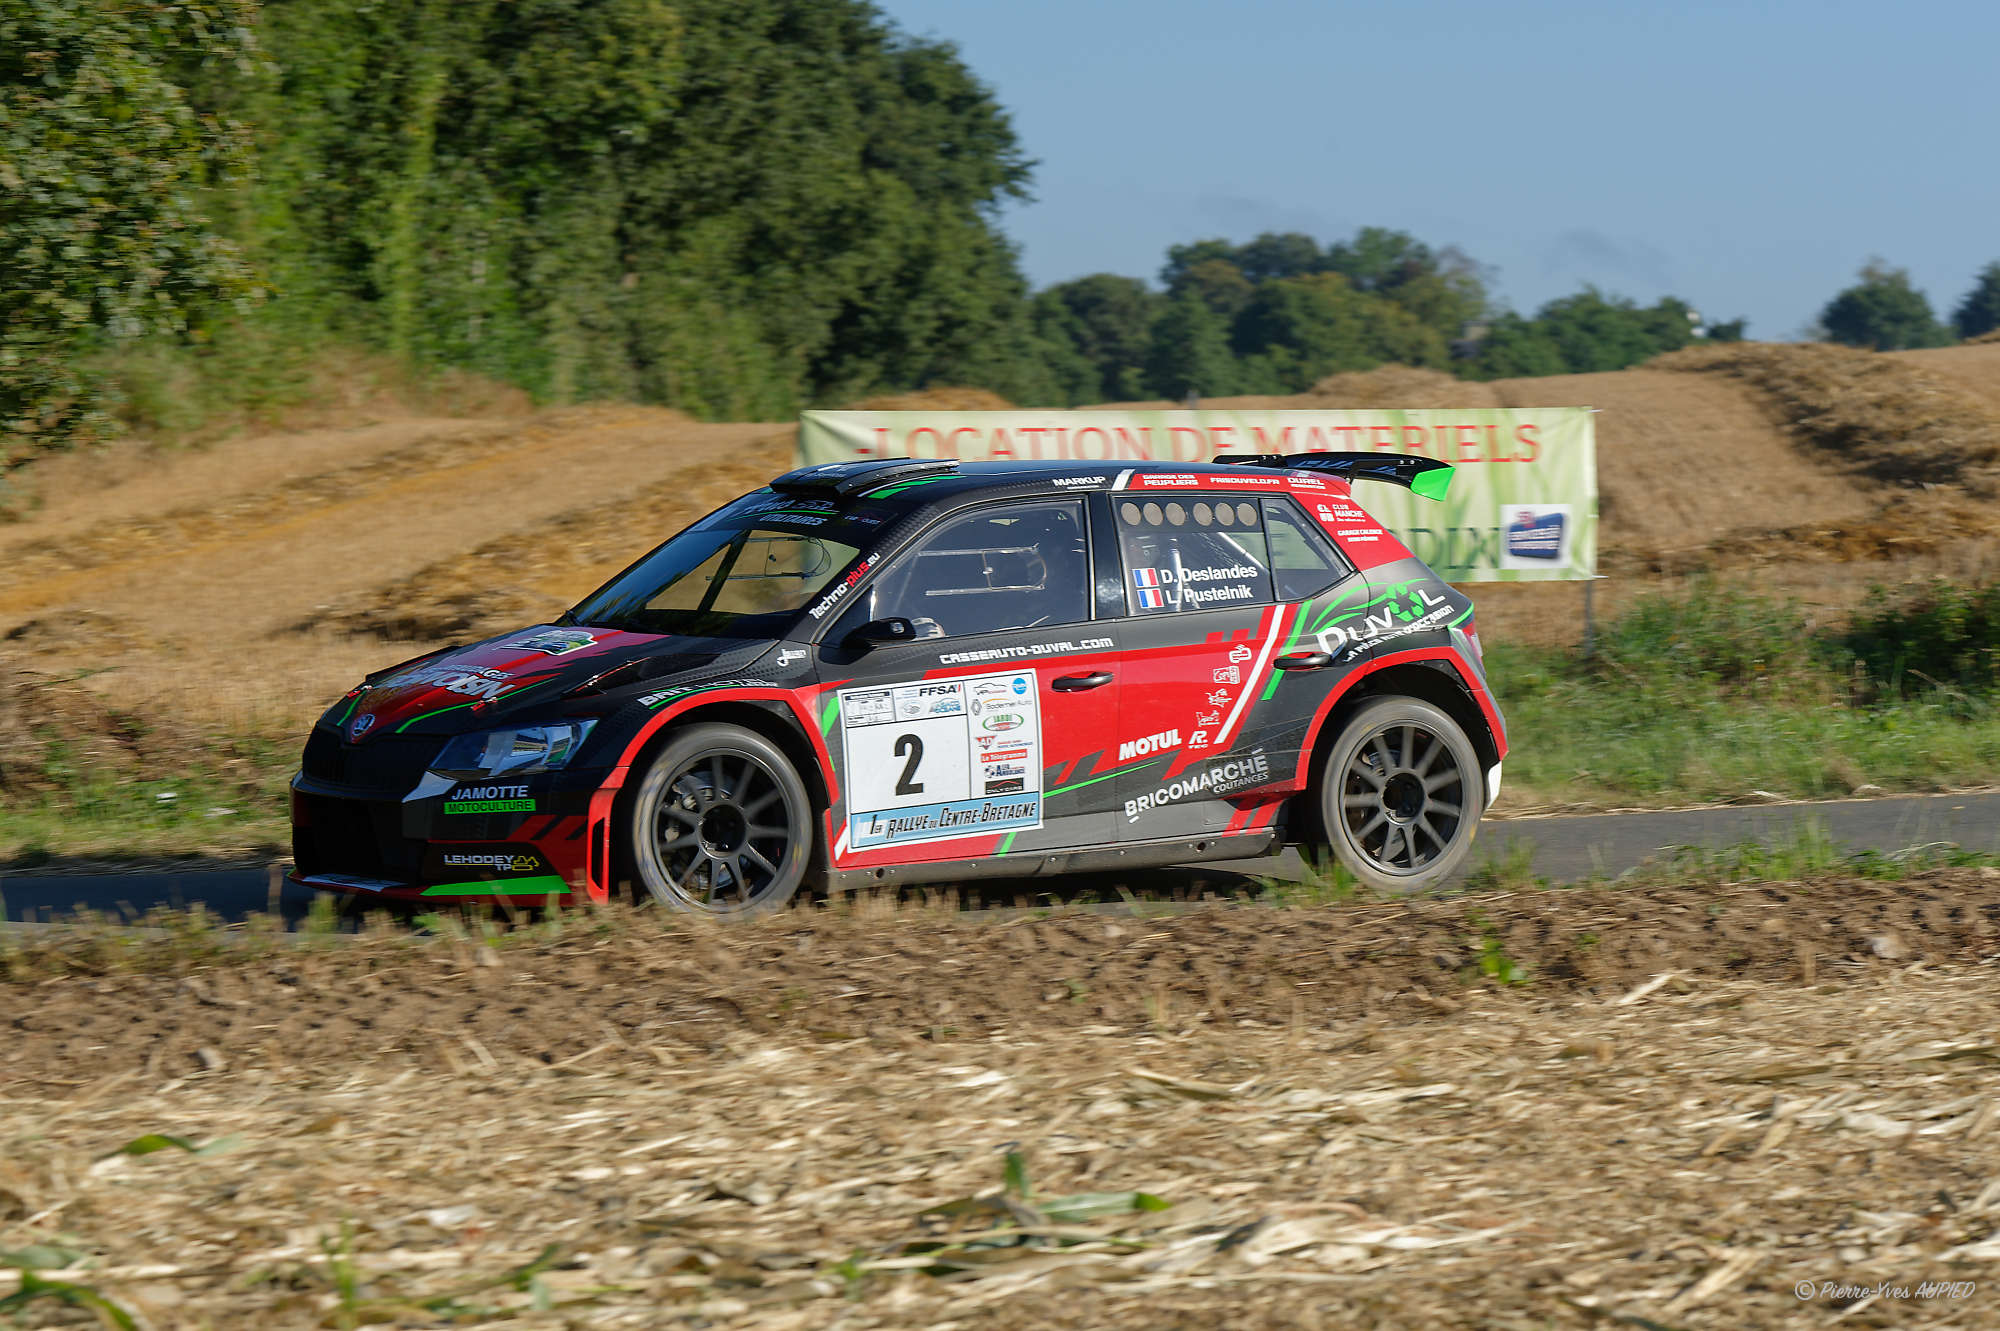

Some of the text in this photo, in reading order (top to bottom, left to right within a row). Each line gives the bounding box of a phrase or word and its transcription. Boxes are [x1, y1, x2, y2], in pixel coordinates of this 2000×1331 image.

[1167, 426, 1234, 460] DE
[1246, 425, 1542, 463] MATERIELS
[1052, 476, 1105, 487] MARKUP
[1160, 565, 1258, 584] D. Deslandes
[808, 552, 881, 619] Techno-plus.eu
[919, 684, 957, 697] FFSA
[1119, 729, 1182, 761] MOTUL
[894, 733, 924, 796] 2
[1125, 748, 1269, 818] BRICOMARCHÉ
[1213, 772, 1269, 795] COUTANCES
[451, 785, 529, 801] JAMOTTE
[448, 800, 532, 812] MOTOCULTURE
[444, 855, 515, 864] LEHODEY
[495, 863, 512, 871] TP
